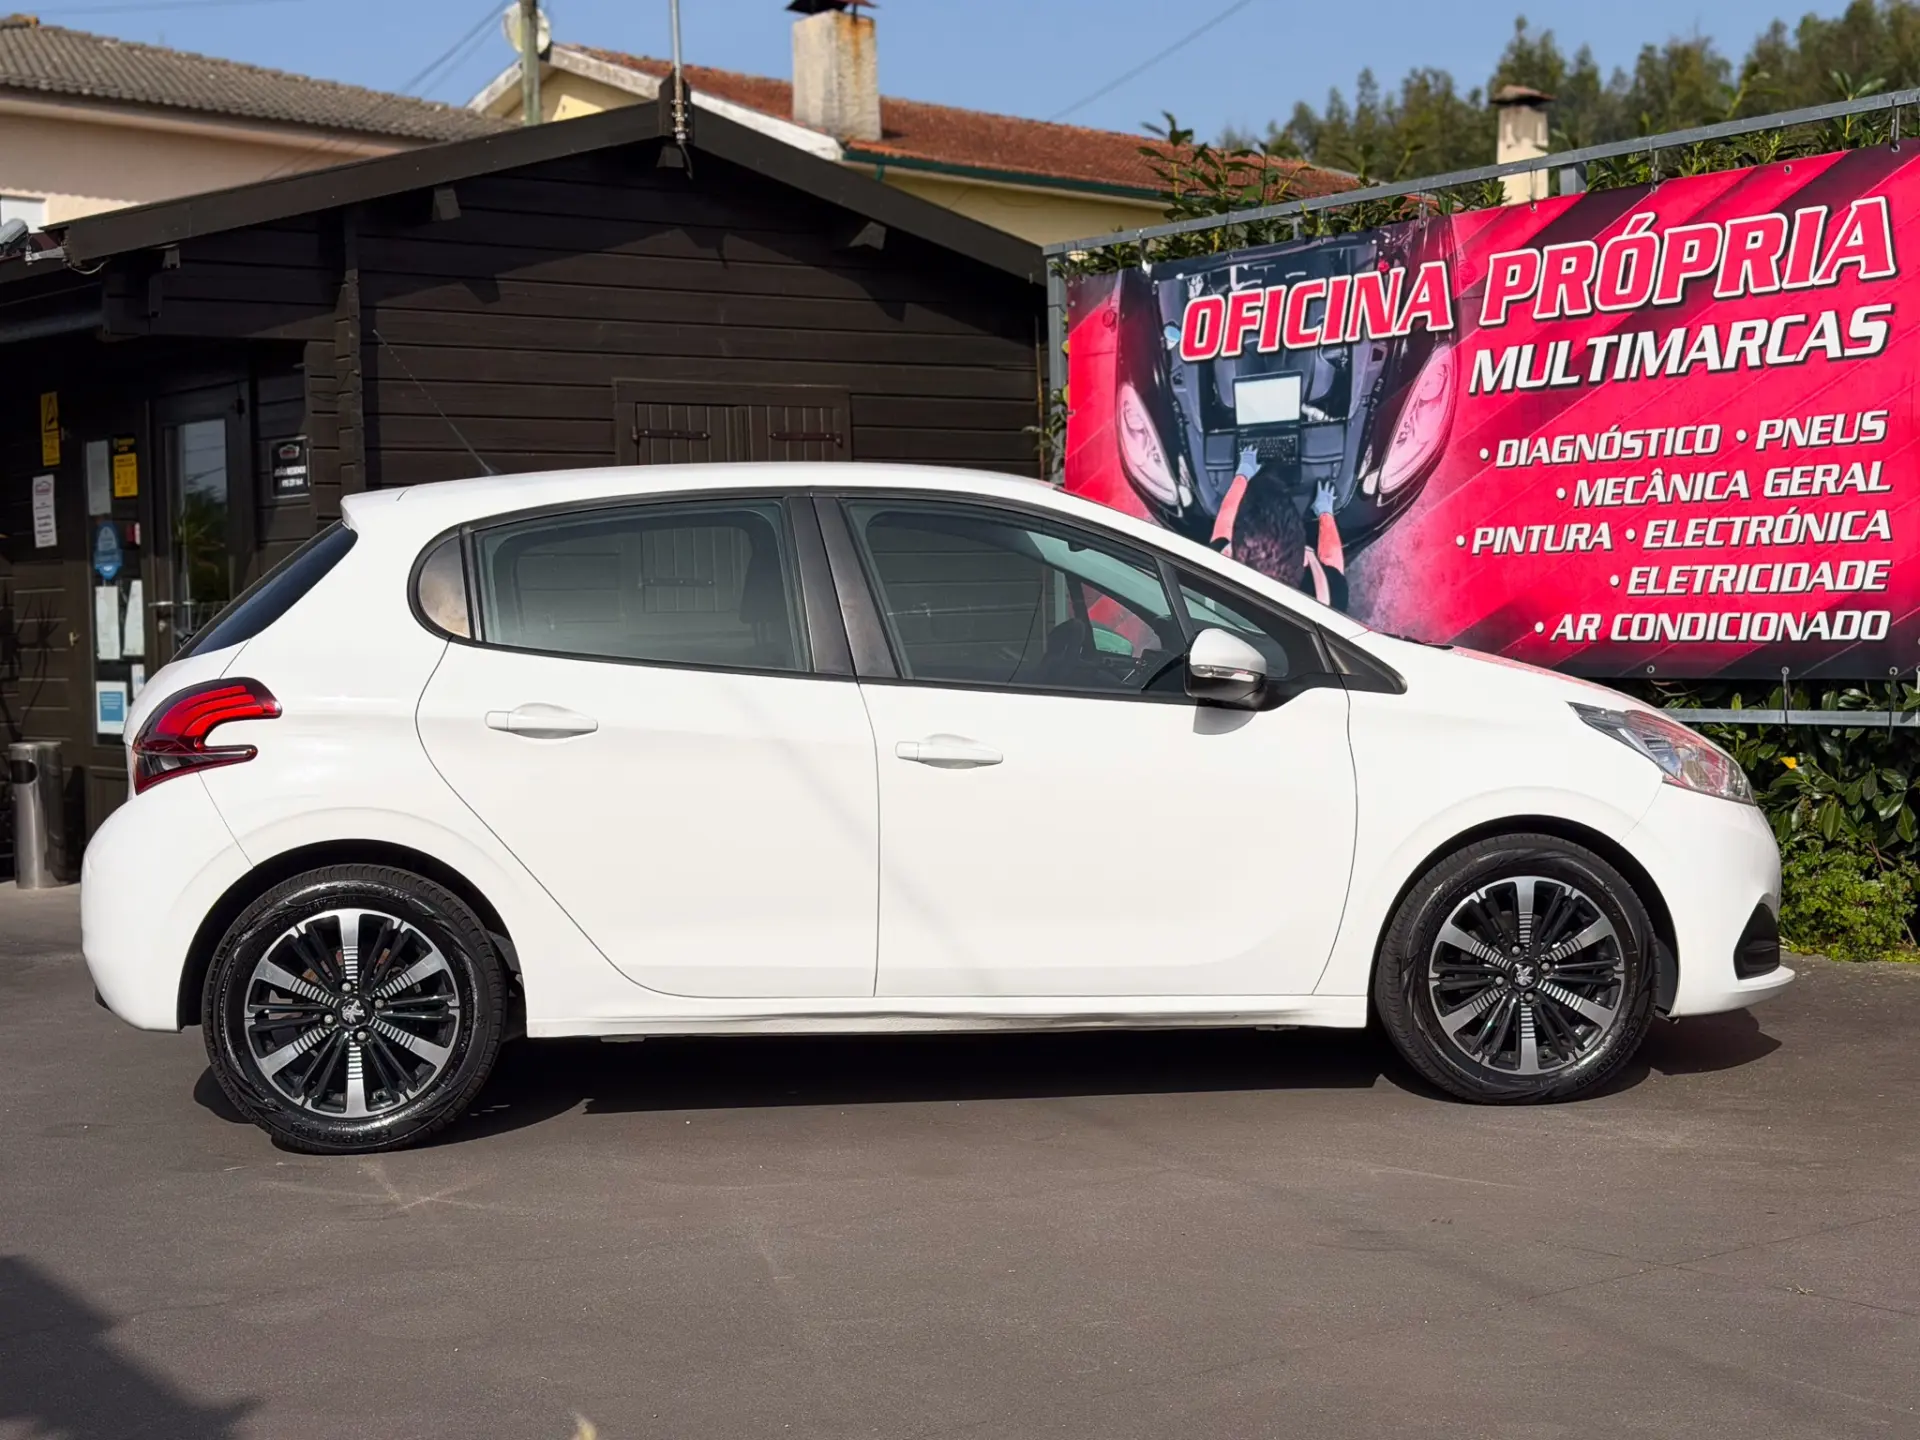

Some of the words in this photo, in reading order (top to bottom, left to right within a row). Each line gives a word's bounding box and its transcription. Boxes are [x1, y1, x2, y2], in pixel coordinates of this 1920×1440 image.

[1180, 261, 1454, 361] OFICINA
[1479, 196, 1896, 326] PRÓPRIA
[1469, 303, 1892, 393] MULTIMARCAS
[1495, 424, 1721, 467] DIAGNÓSTICO
[1755, 410, 1888, 450] PNEUS
[1574, 468, 1749, 507] MECÂNICA
[1763, 461, 1891, 497] GERAL
[1471, 522, 1612, 554] PINTURA
[1642, 506, 1891, 548] ELECTRÓNICA
[1626, 559, 1891, 595] ELETRICIDADE
[1551, 612, 1600, 641] AR
[1611, 610, 1891, 641] CONDICIONADO
